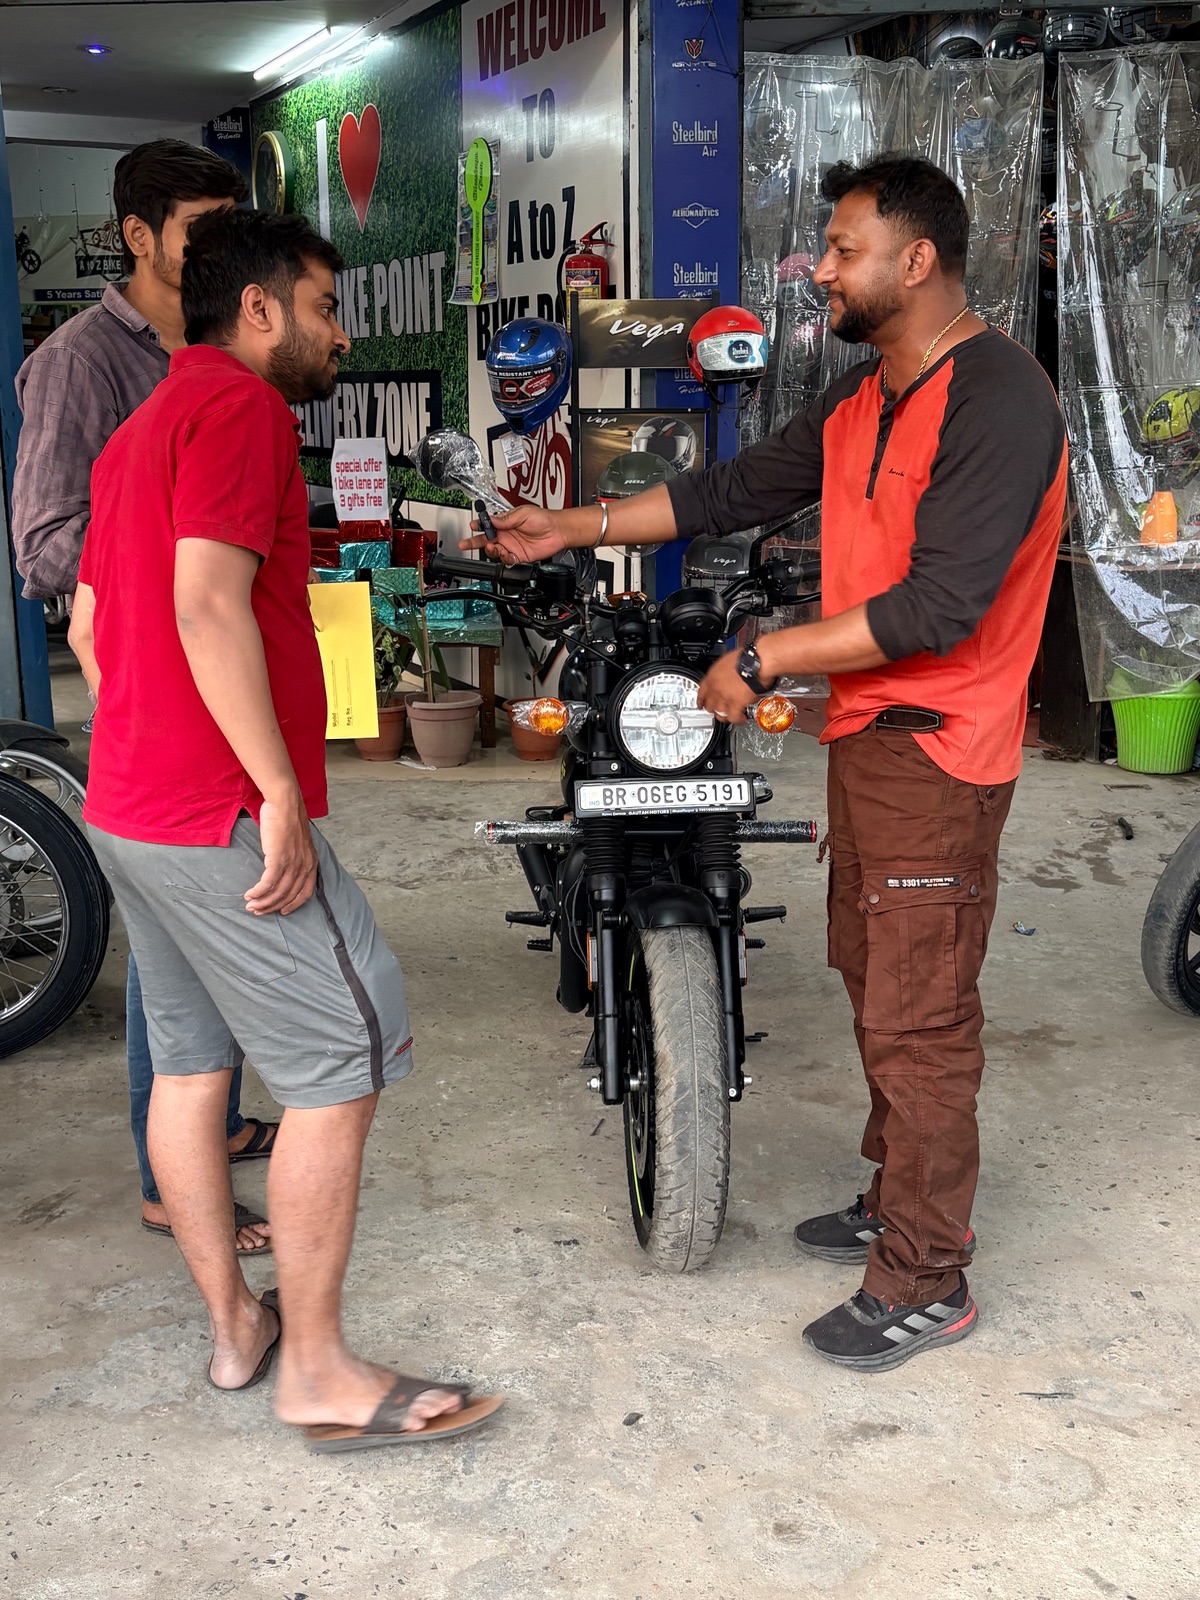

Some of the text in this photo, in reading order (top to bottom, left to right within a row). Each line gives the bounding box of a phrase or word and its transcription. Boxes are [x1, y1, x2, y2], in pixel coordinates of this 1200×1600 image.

[477, 0, 606, 82] WELCOME
[213, 116, 242, 131] Steelbird
[522, 88, 555, 163] TO
[673, 120, 718, 143] Steelbird
[702, 145, 718, 157] Air
[672, 209, 719, 217] AERONAUTICS
[507, 200, 524, 265] A
[528, 200, 556, 260] to
[562, 186, 576, 253] Z
[96, 260, 101, 270] Z
[103, 259, 122, 270] BIKE
[673, 262, 718, 284] Steelbird
[55, 290, 82, 298] Years
[334, 266, 370, 339] IKE
[373, 251, 446, 337] POINT
[534, 366, 551, 375] VISOR
[290, 381, 431, 457] ELIVERY ZONE
[336, 458, 382, 476] special offer
[339, 476, 353, 490] bike
[355, 476, 372, 489] lene
[374, 478, 386, 493] per
[340, 493, 382, 511] 3 gifts free
[602, 787, 627, 806] BR
[696, 783, 743, 801] 5191
[902, 879, 920, 887] 3301
